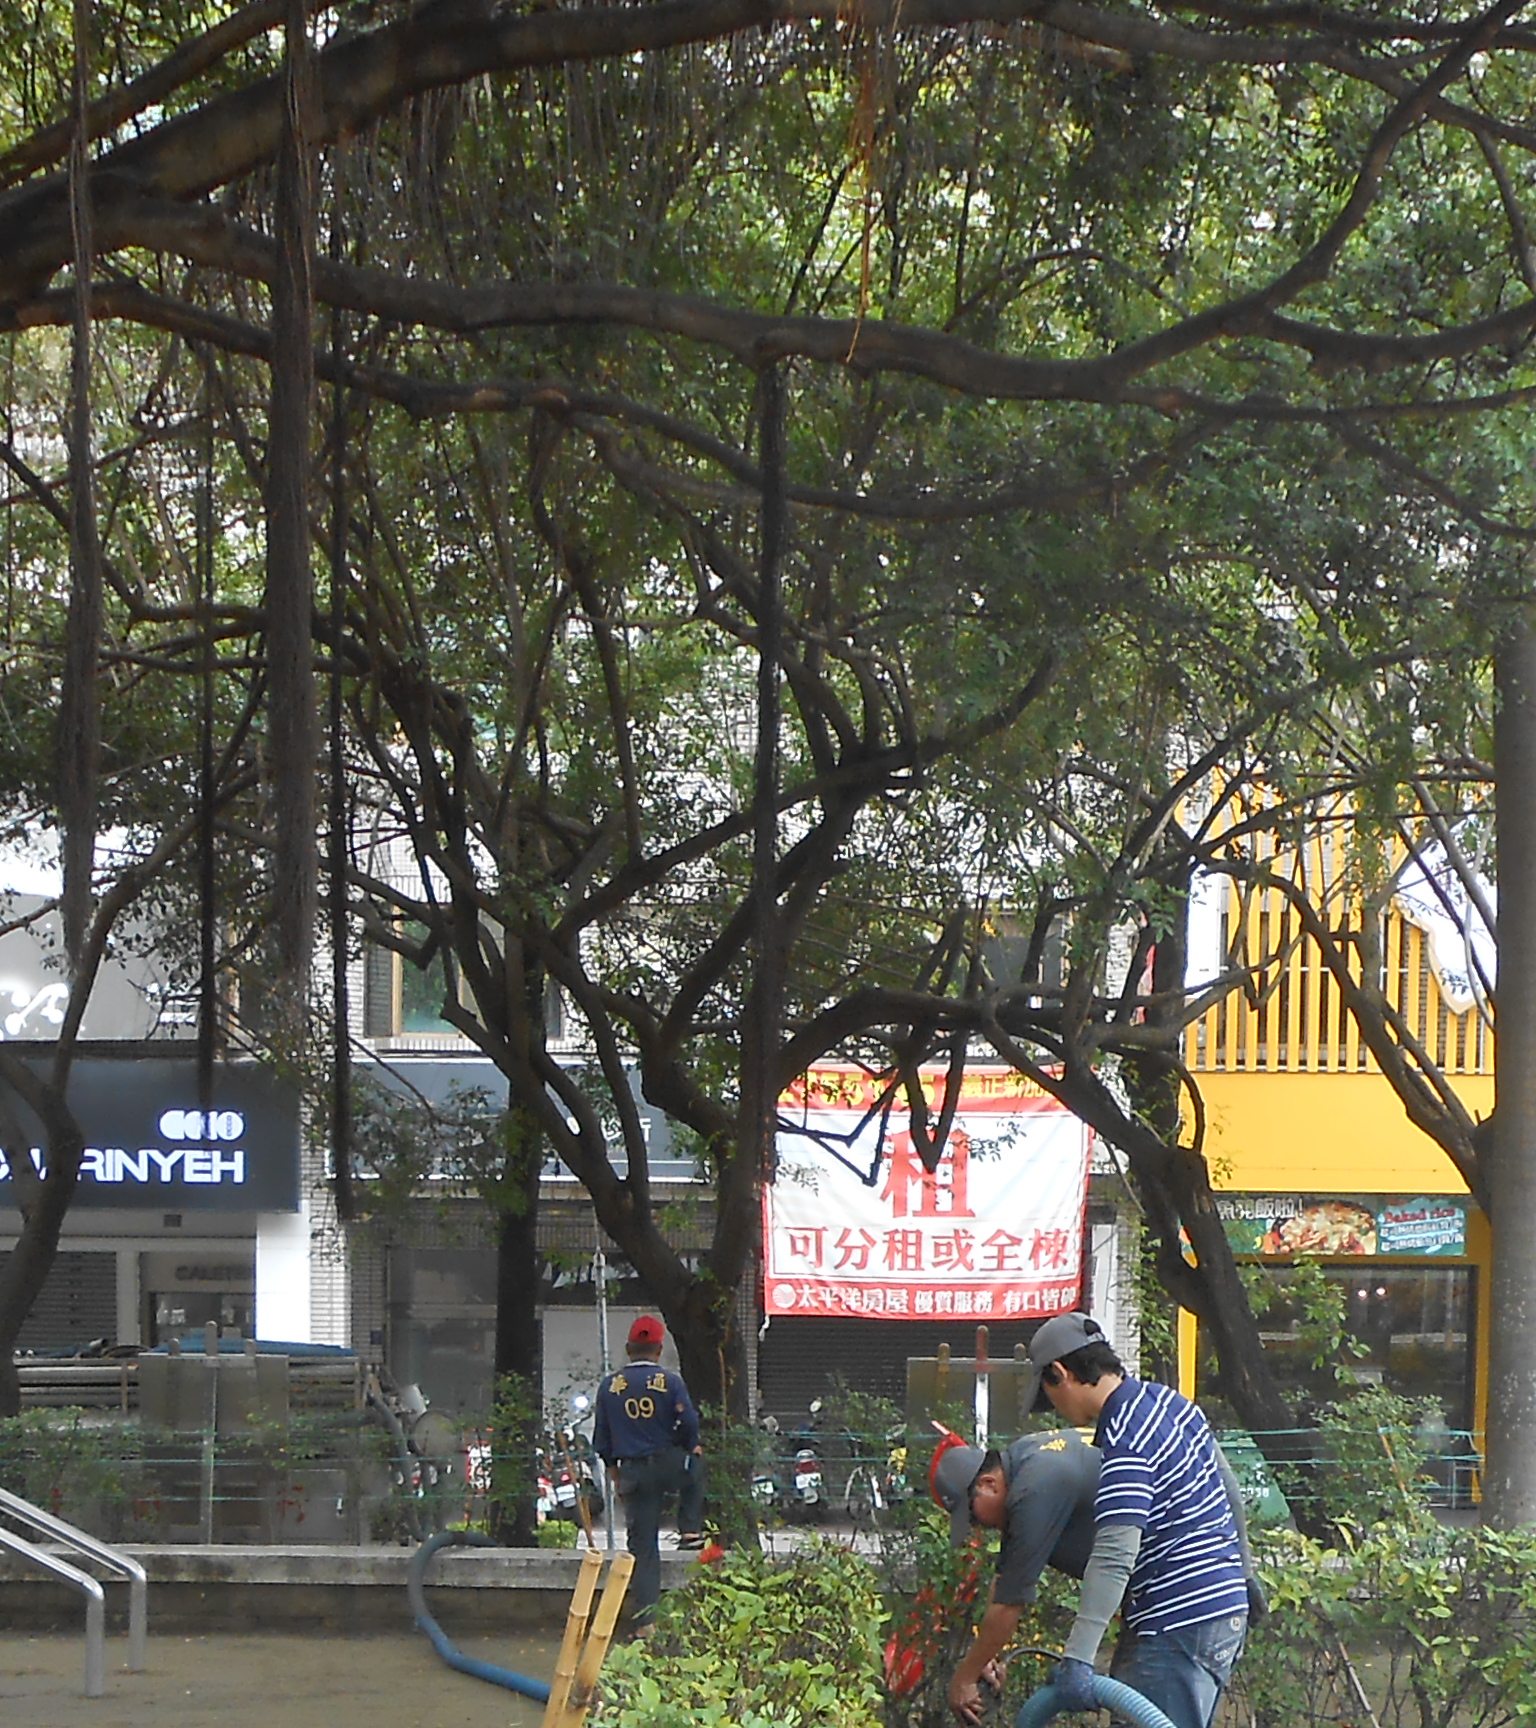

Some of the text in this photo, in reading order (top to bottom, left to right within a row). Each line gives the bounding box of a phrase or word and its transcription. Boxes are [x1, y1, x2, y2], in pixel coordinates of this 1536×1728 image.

[879, 1126, 976, 1218] 租
[785, 1227, 1072, 1272] 可分租或全棟
[797, 1284, 909, 1314] 太平洋房屋
[913, 1286, 994, 1314] 優質服務
[624, 1396, 655, 1420] 09
